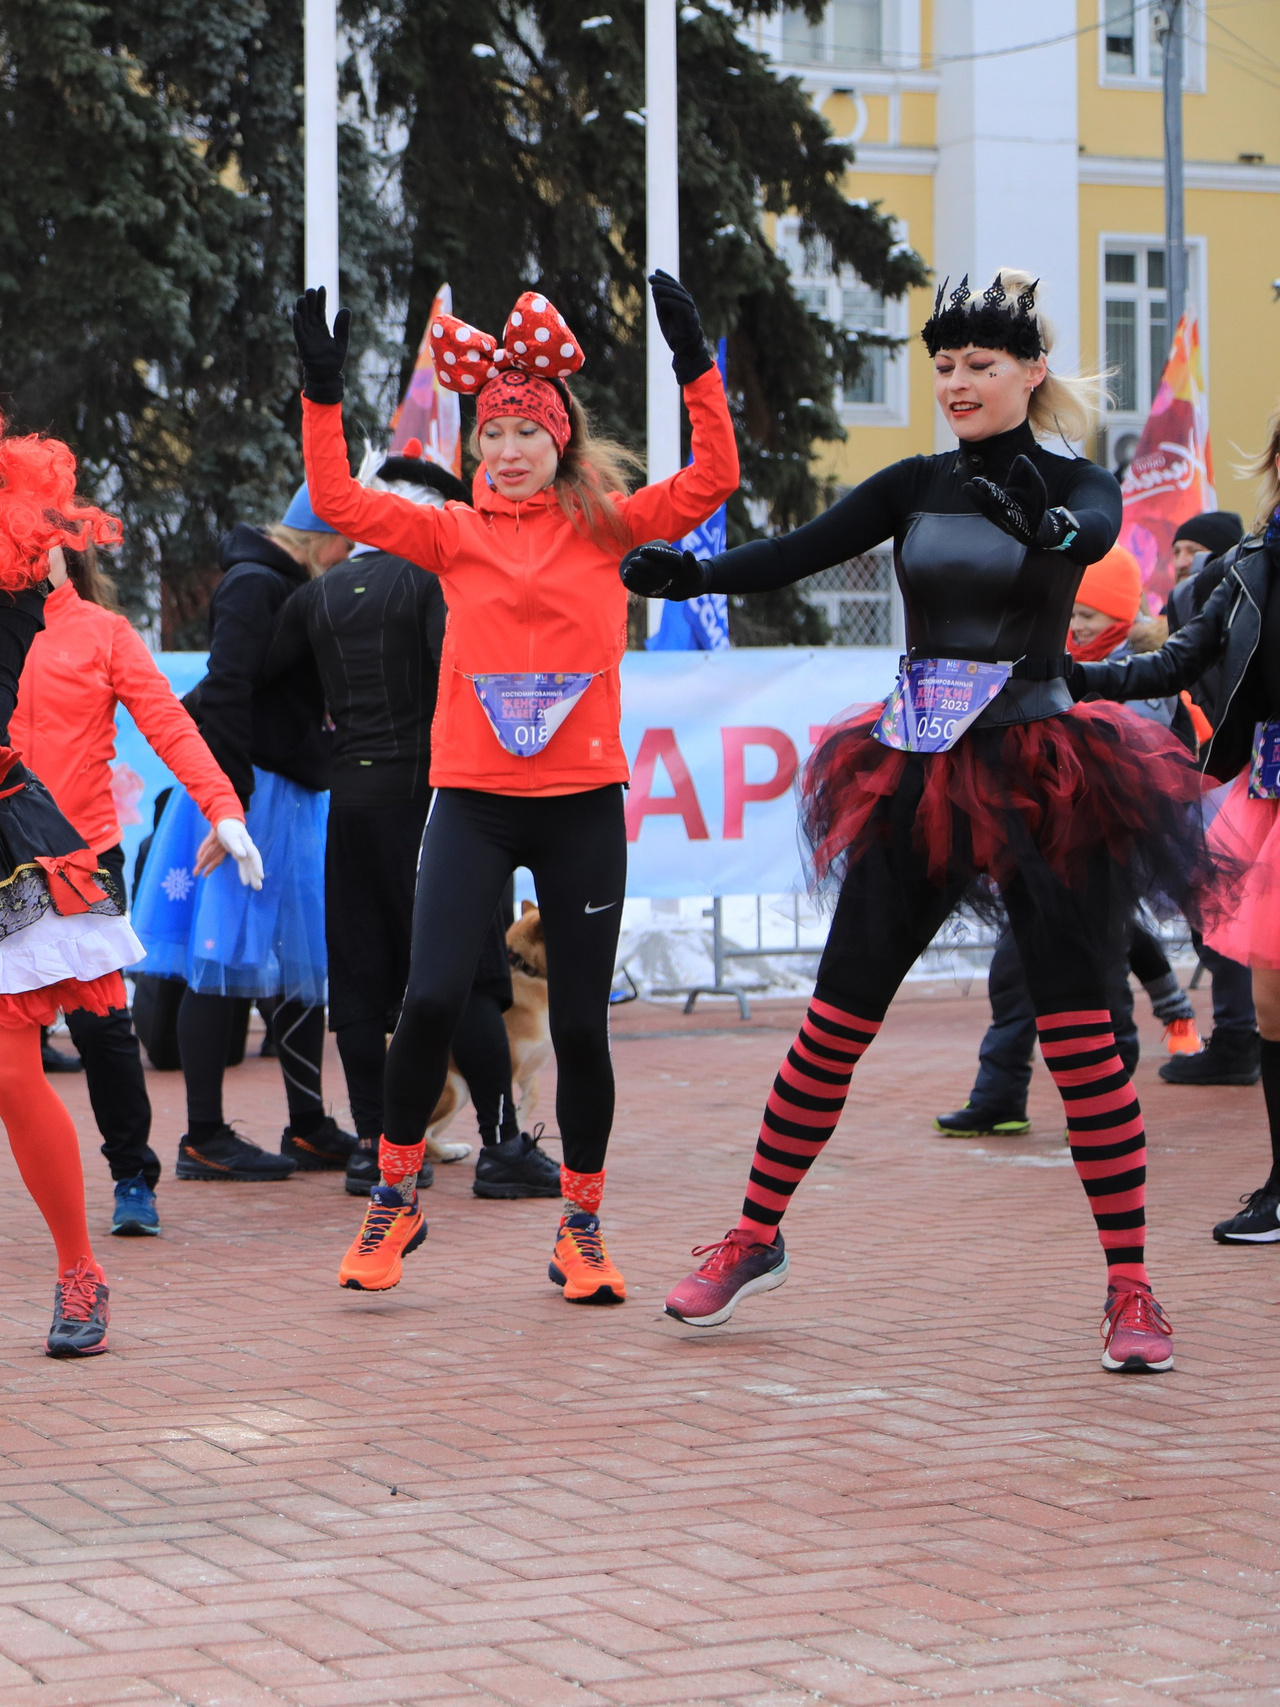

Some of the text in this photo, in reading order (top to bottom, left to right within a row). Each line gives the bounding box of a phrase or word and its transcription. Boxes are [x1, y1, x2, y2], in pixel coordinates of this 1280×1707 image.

[917, 678, 973, 688] КОСТЮМИРОВАННЫЙ
[501, 690, 563, 698] КОСТЮМИРОВАННЫЙ
[915, 685, 973, 701] ЖЕНСКИЙ
[913, 698, 969, 711] ЗАБЕГ 2023
[501, 708, 534, 719] ЗАБЕГ
[515, 725, 548, 745] 018
